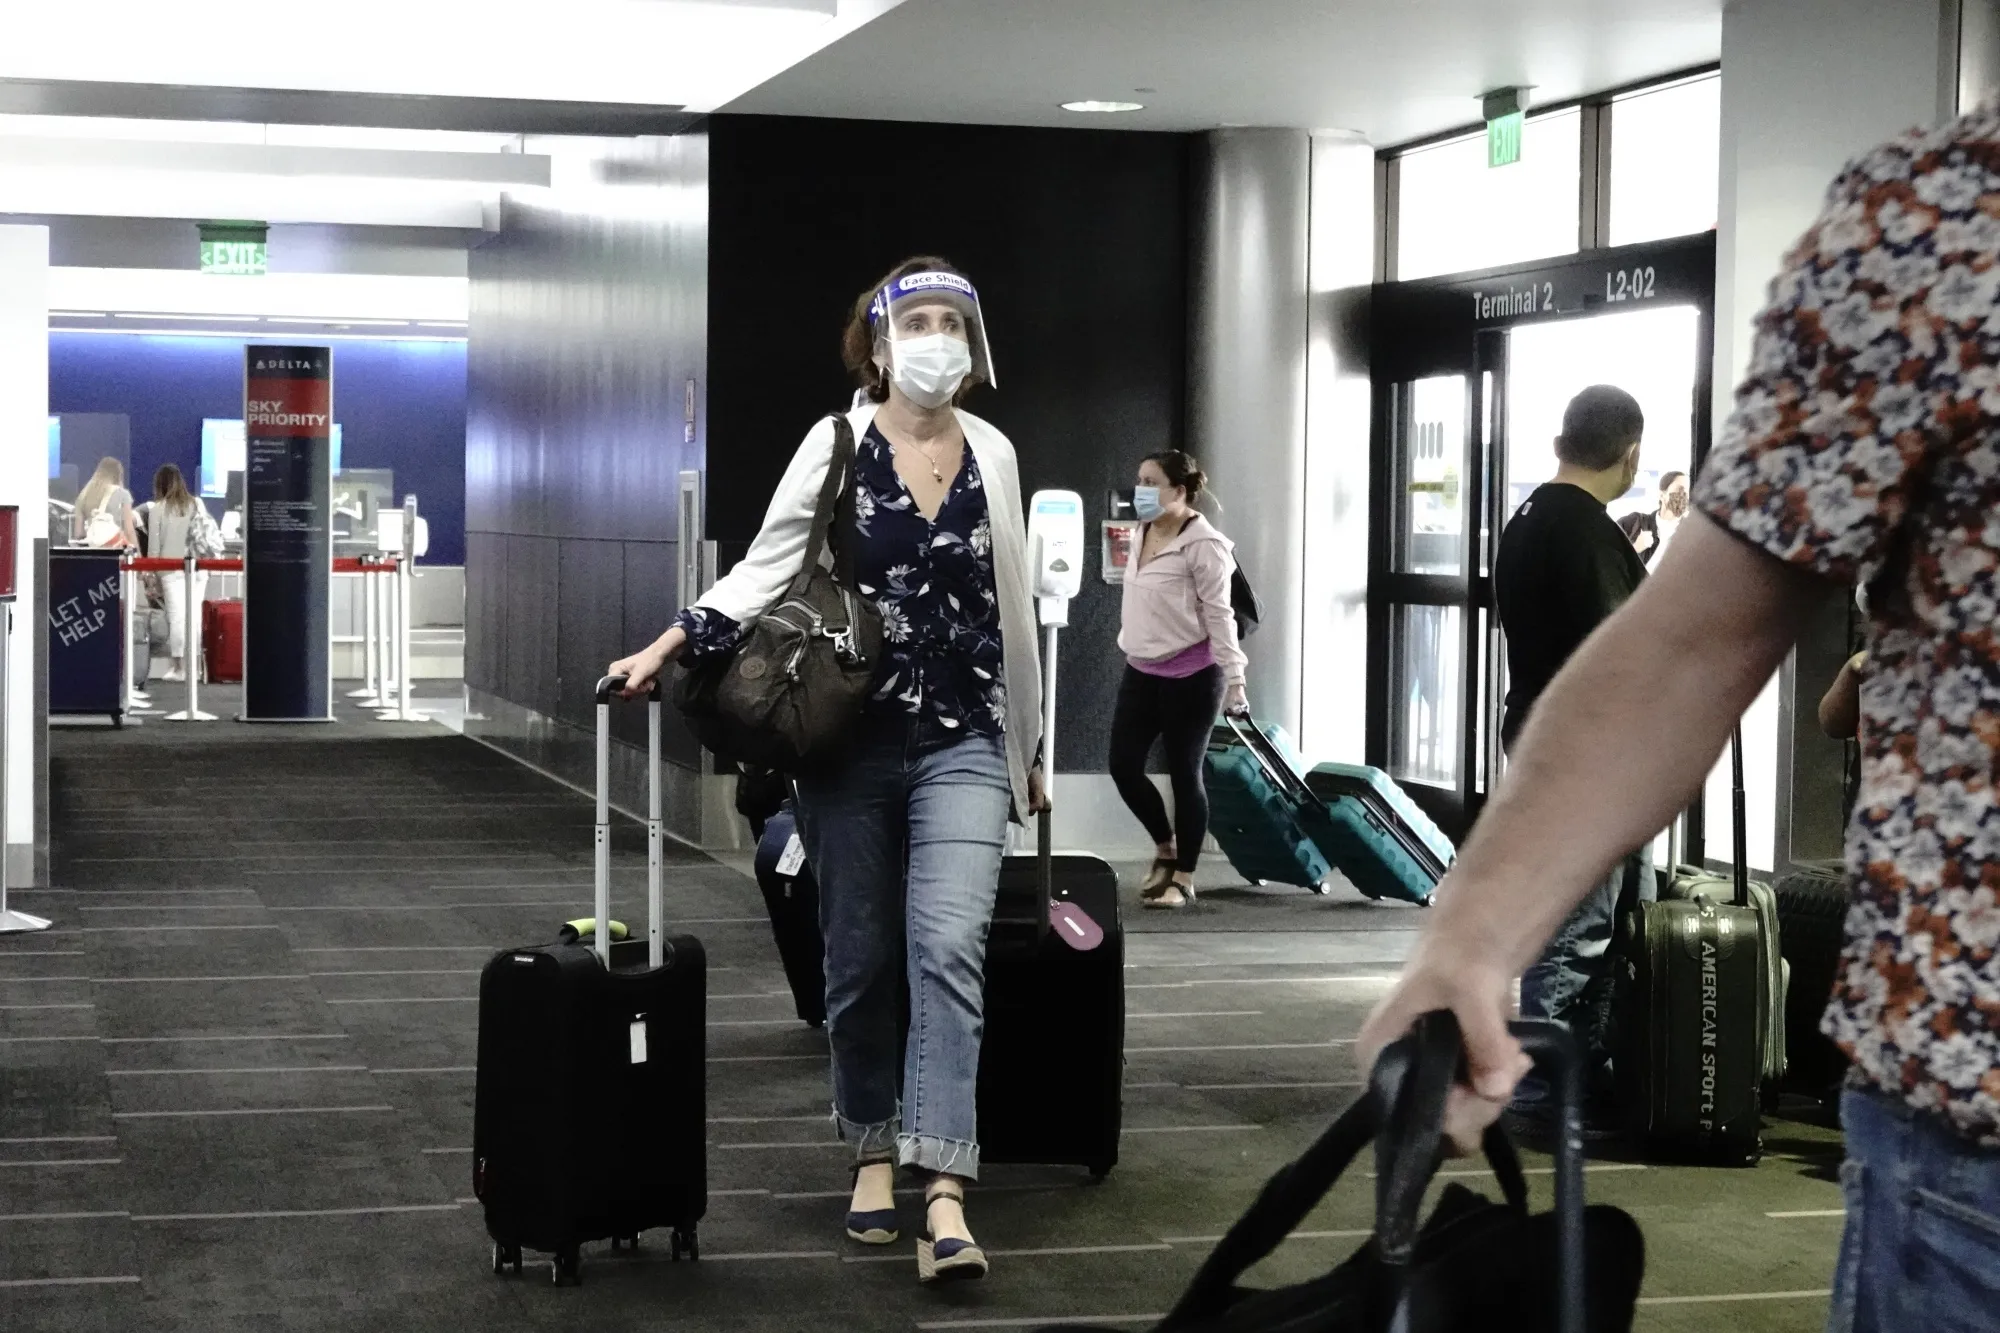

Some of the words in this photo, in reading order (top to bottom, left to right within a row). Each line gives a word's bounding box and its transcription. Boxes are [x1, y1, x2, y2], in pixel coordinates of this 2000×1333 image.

[1493, 113, 1520, 165] EXIT
[213, 242, 257, 272] EXIT
[905, 276, 932, 288] Face
[935, 274, 969, 290] Shield
[1606, 266, 1655, 302] L2-02
[1473, 283, 1537, 320] Terminal
[1543, 281, 1553, 311] 2
[268, 360, 311, 370] DELTA
[248, 400, 282, 413] SKY
[248, 413, 327, 426] PRIORITY
[48, 596, 82, 628] LET
[88, 576, 120, 605] ME
[59, 609, 106, 647] HELP
[1702, 941, 1717, 1047] AMERICAN
